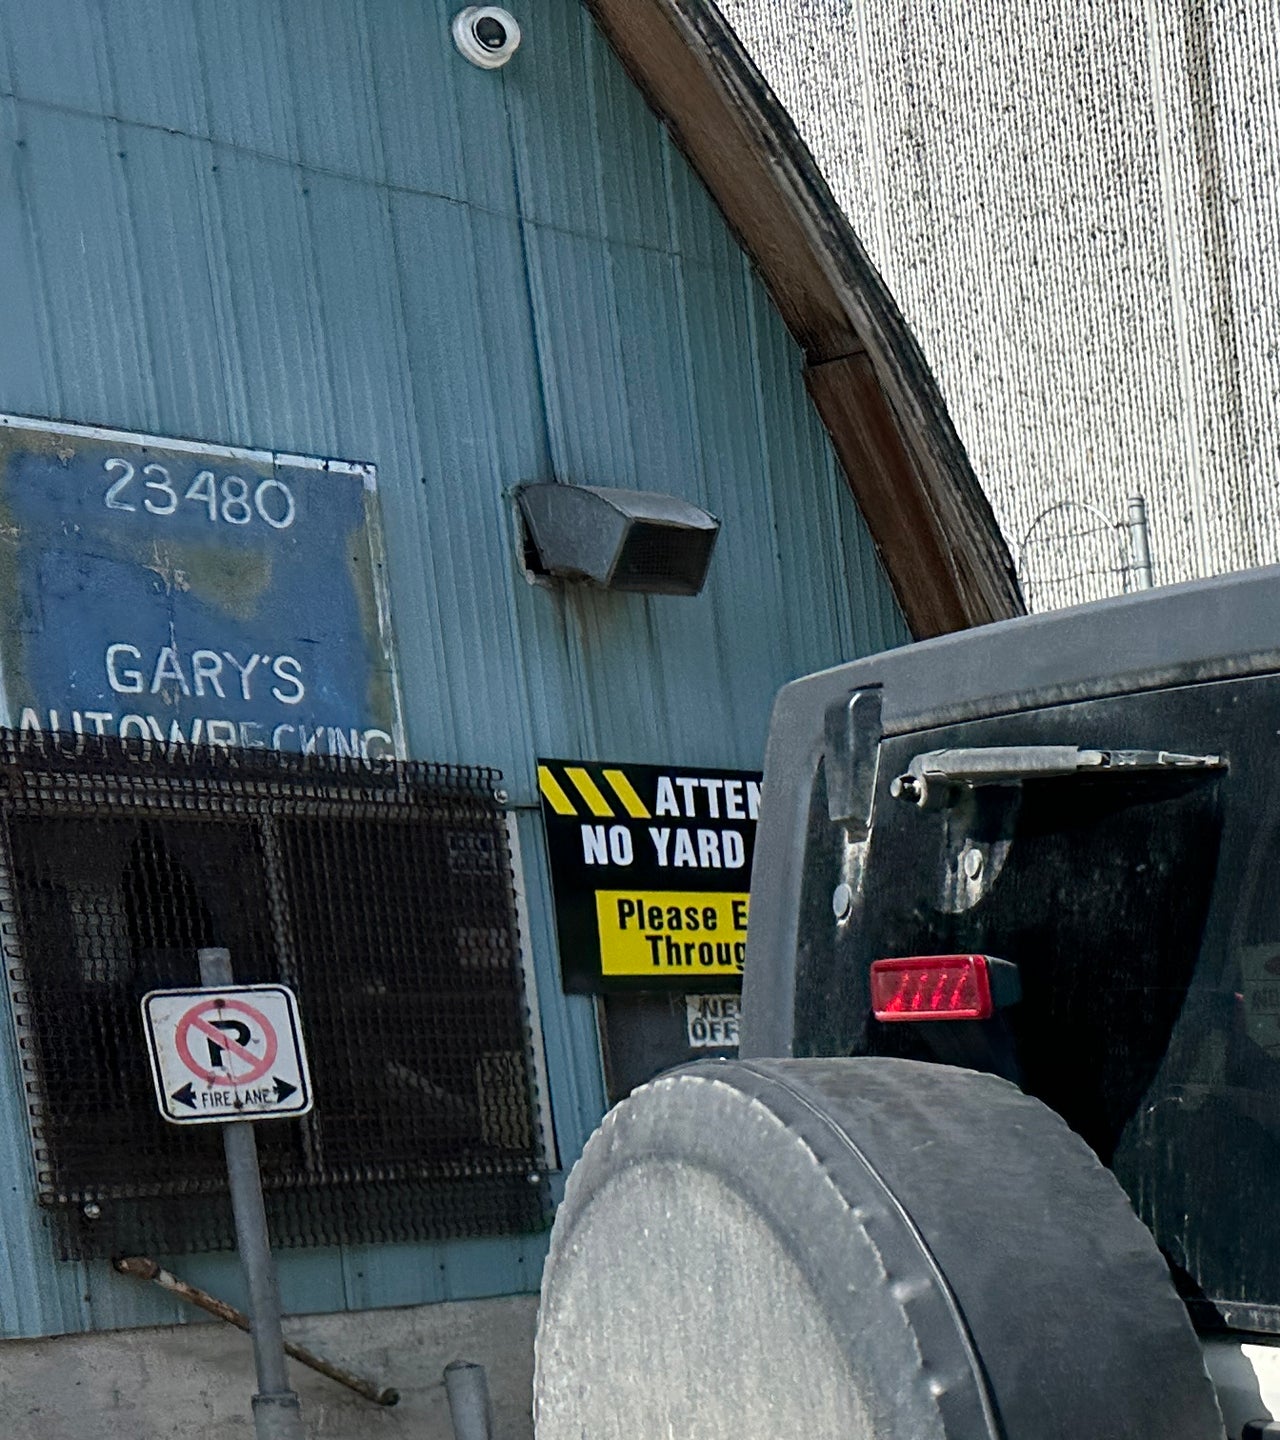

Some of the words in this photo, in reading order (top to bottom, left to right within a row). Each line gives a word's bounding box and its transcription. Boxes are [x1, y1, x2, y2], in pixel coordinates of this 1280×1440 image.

[104, 457, 295, 529] 23480
[106, 643, 306, 704] GARY'S
[581, 824, 634, 866] NO
[648, 827, 745, 869] YARD
[617, 899, 718, 930] Please
[202, 1091, 232, 1108] FIRE
